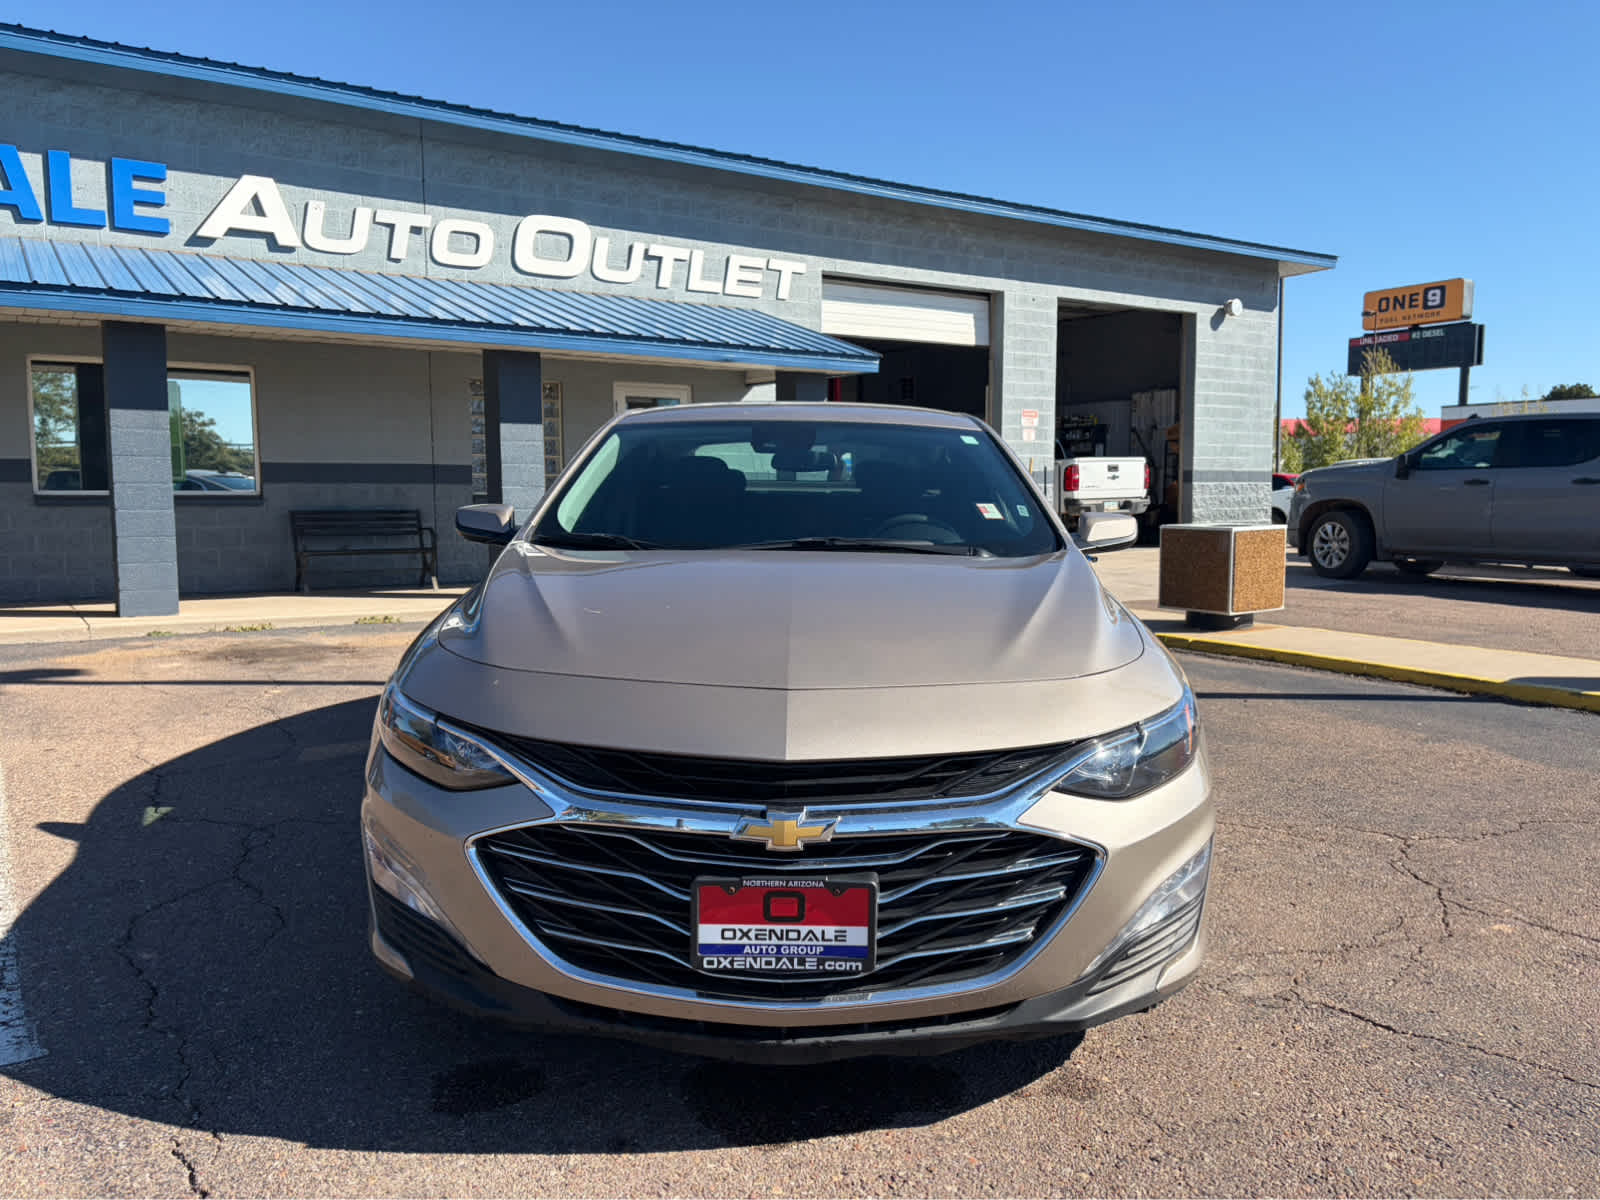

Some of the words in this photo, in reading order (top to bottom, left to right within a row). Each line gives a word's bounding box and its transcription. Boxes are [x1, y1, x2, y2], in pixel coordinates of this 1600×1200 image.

[196, 174, 495, 268] AUTO
[513, 214, 807, 300] OUTLET
[1378, 292, 1420, 313] ONE
[742, 879, 786, 888] NORTHERN
[787, 880, 825, 889] ARIZONA
[720, 927, 848, 943] OXENDALE
[743, 945, 777, 955] AUTO
[781, 945, 825, 956] GROUP
[702, 956, 863, 972] OXENDALE.com
